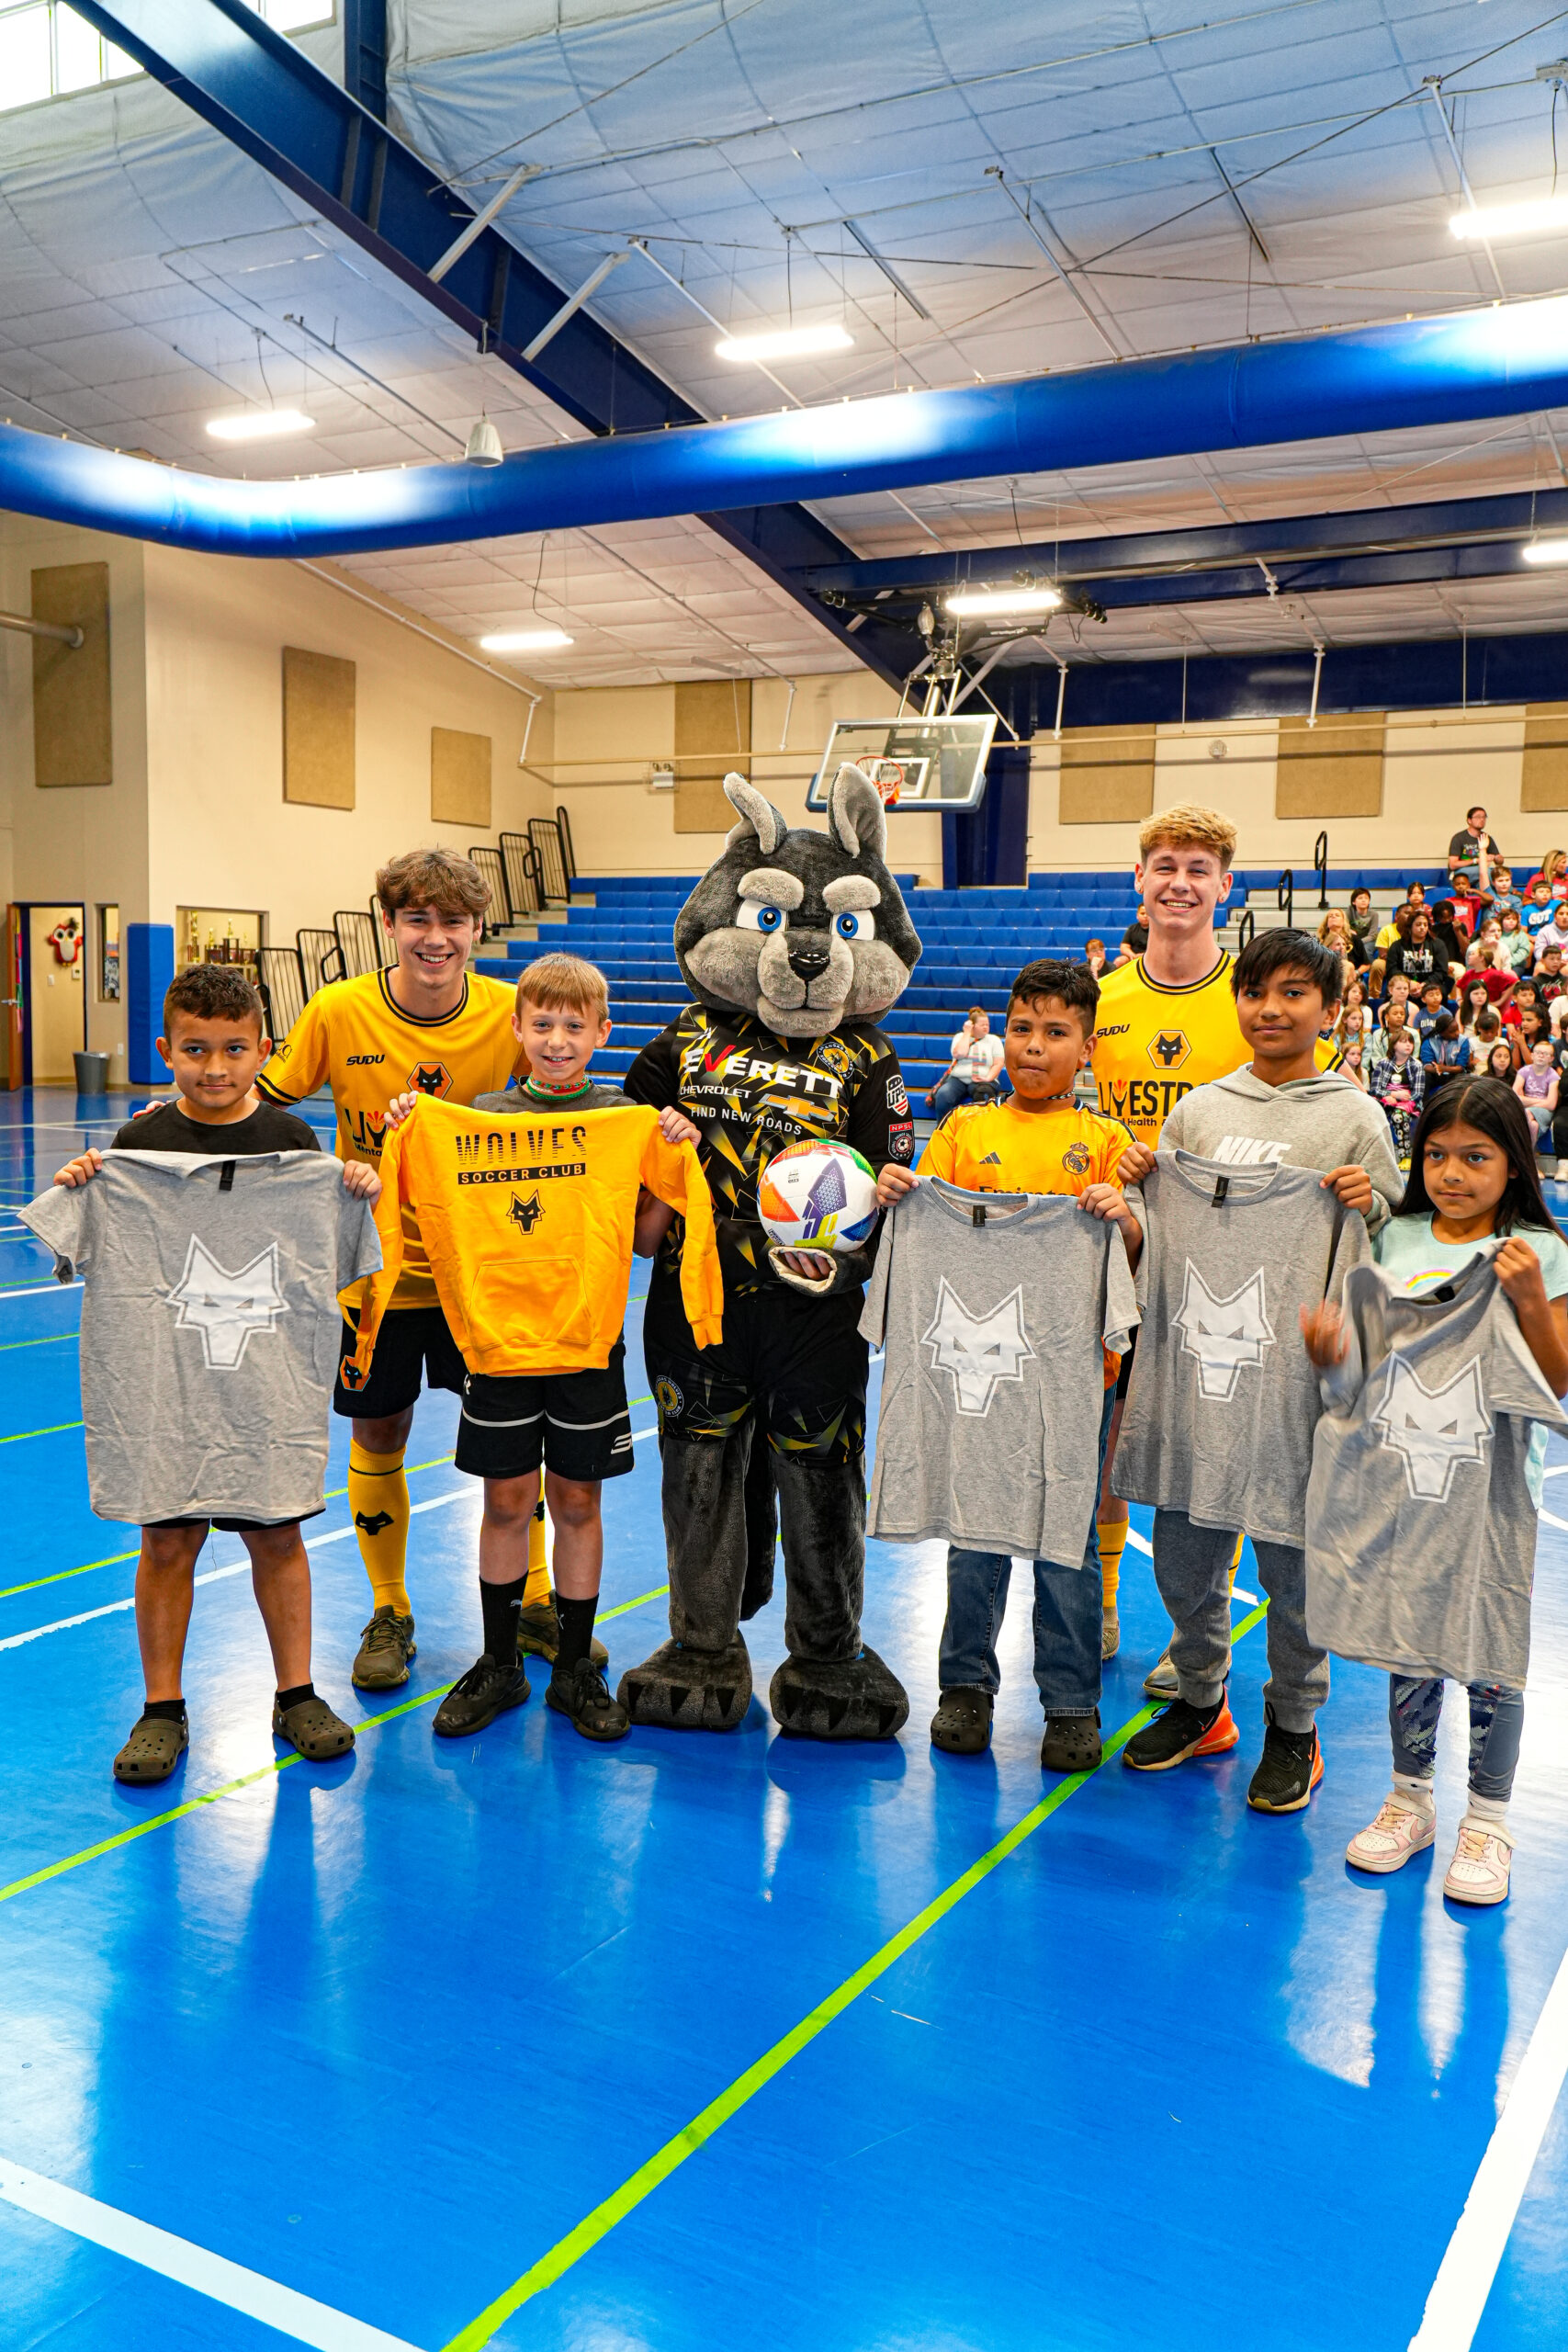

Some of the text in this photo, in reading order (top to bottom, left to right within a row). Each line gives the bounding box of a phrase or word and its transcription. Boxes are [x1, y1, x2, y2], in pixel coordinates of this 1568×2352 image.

[1097, 1023, 1131, 1038] SUDU
[346, 1054, 386, 1066] SUDU
[682, 1044, 843, 1099] EVERETT
[680, 1084, 752, 1099] CHEVROLET
[691, 1106, 803, 1136] FIND NEW ROADS
[891, 1123, 912, 1131] NPSL
[1128, 1118, 1157, 1126] Health
[461, 1163, 582, 1184] SOCCER CLUB
